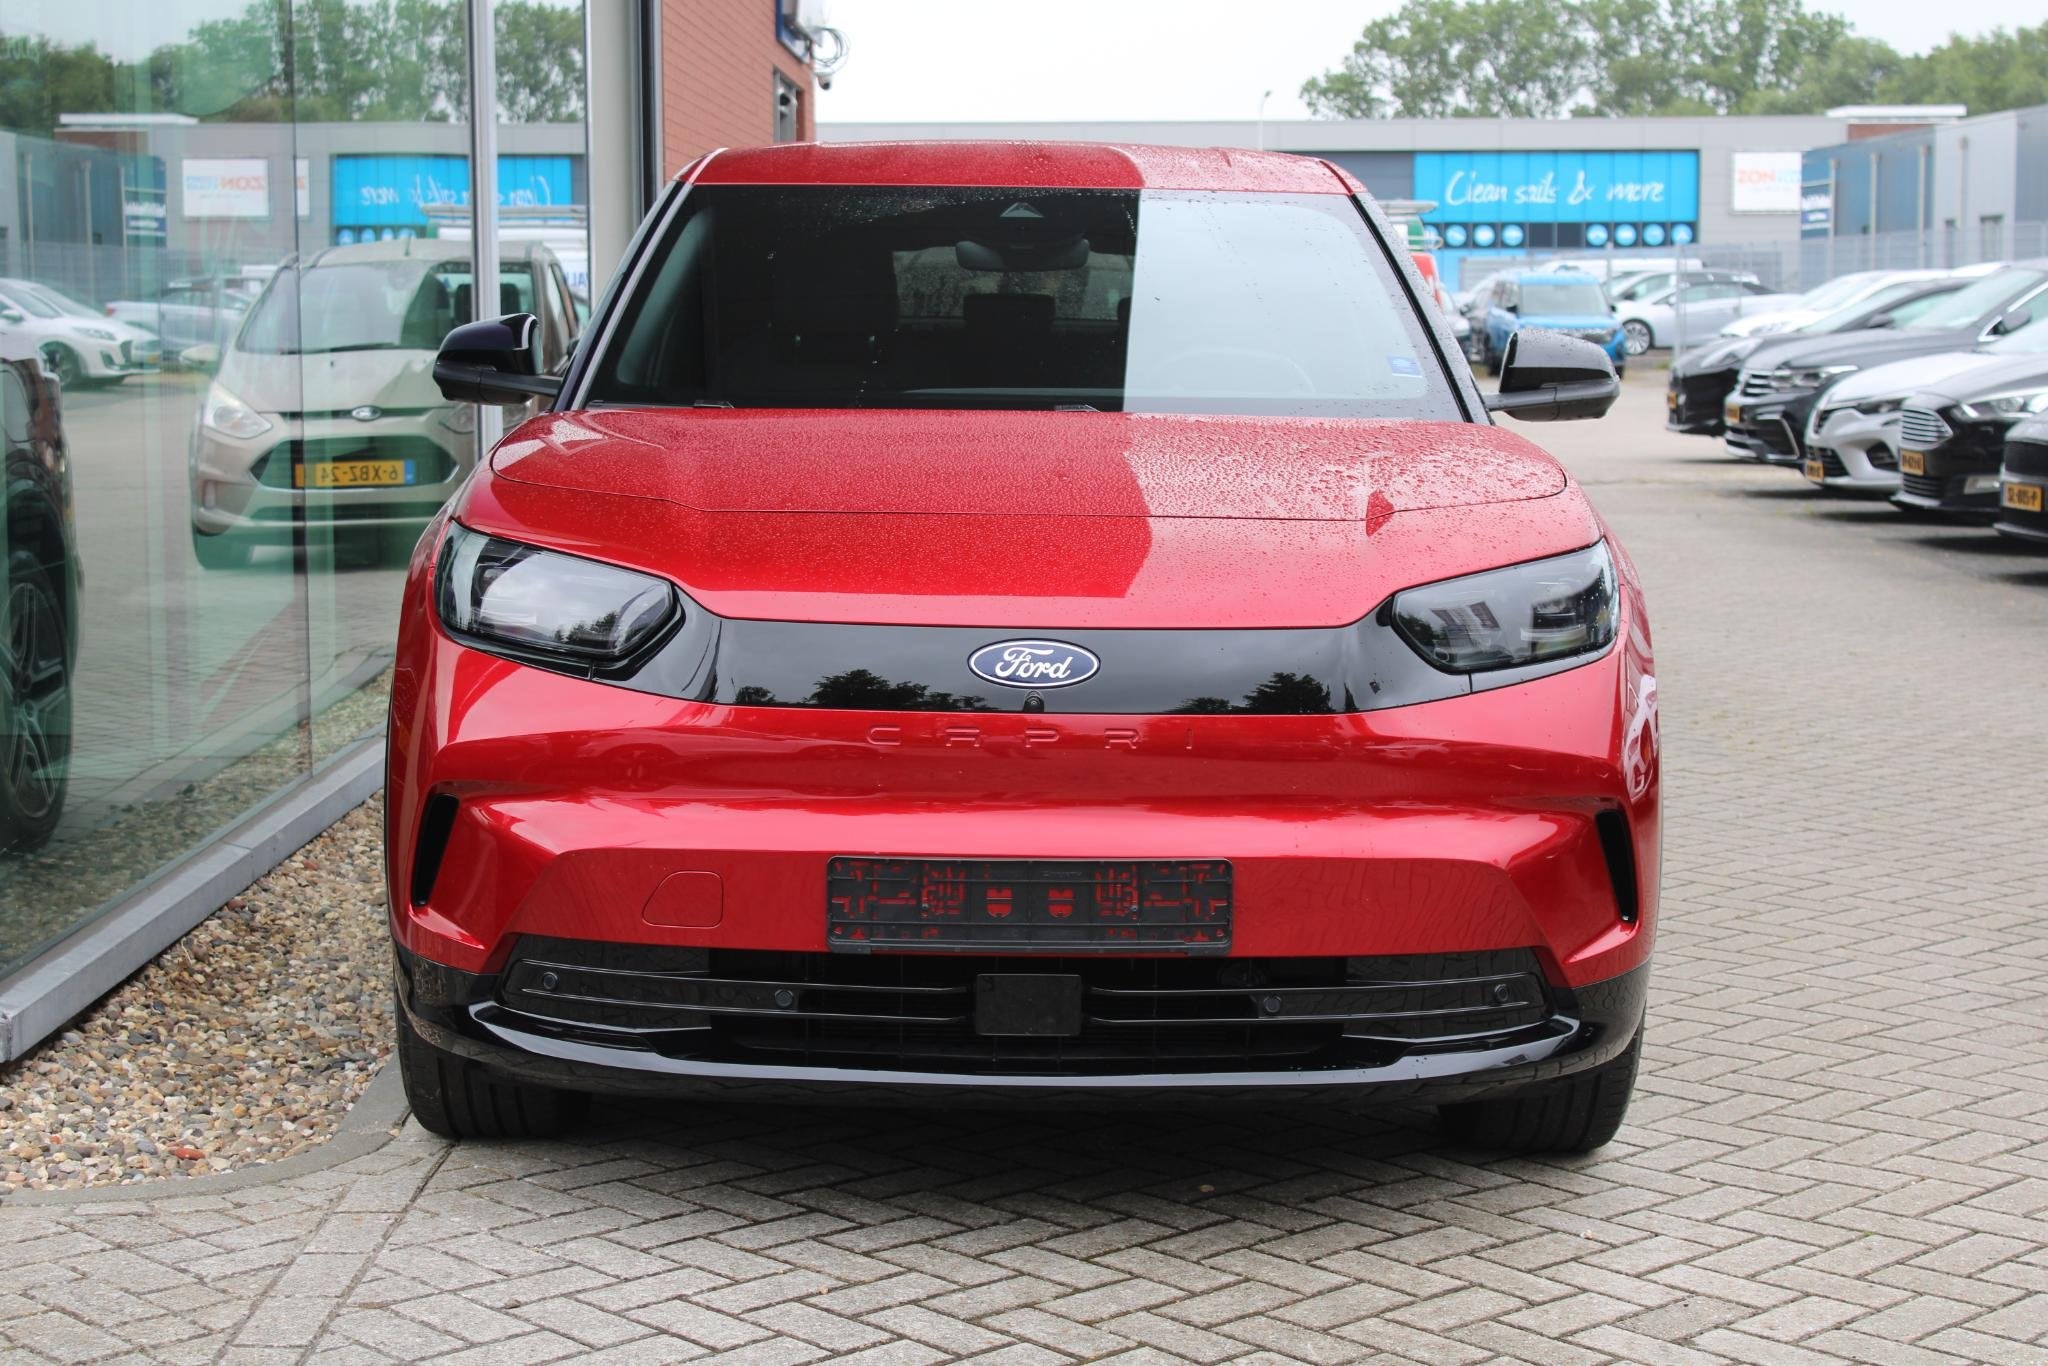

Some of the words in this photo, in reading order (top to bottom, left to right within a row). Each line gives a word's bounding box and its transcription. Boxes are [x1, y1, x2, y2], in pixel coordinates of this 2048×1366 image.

[1446, 170, 1508, 206] Clean
[1566, 170, 1595, 206] &
[1607, 181, 1665, 202] more
[995, 646, 1073, 679] Ford
[866, 727, 1192, 750] CAPRI
